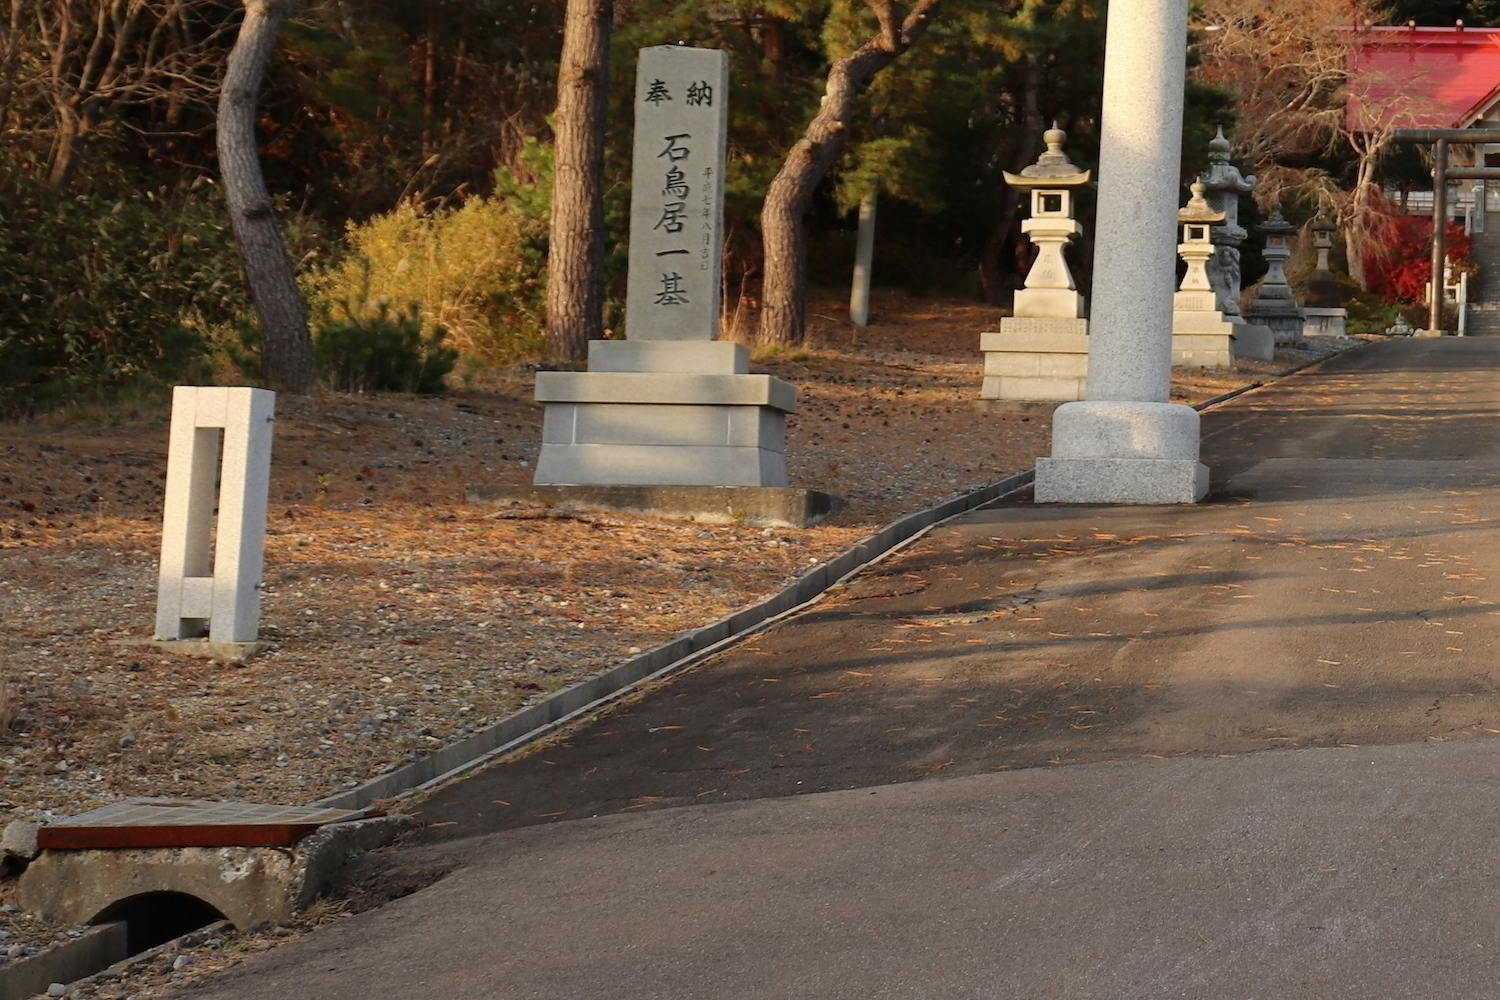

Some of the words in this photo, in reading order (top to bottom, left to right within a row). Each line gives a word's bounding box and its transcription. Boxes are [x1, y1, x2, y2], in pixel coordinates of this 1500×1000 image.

[644, 78, 713, 108] 奉納
[652, 132, 692, 307] 石鳥居一基
